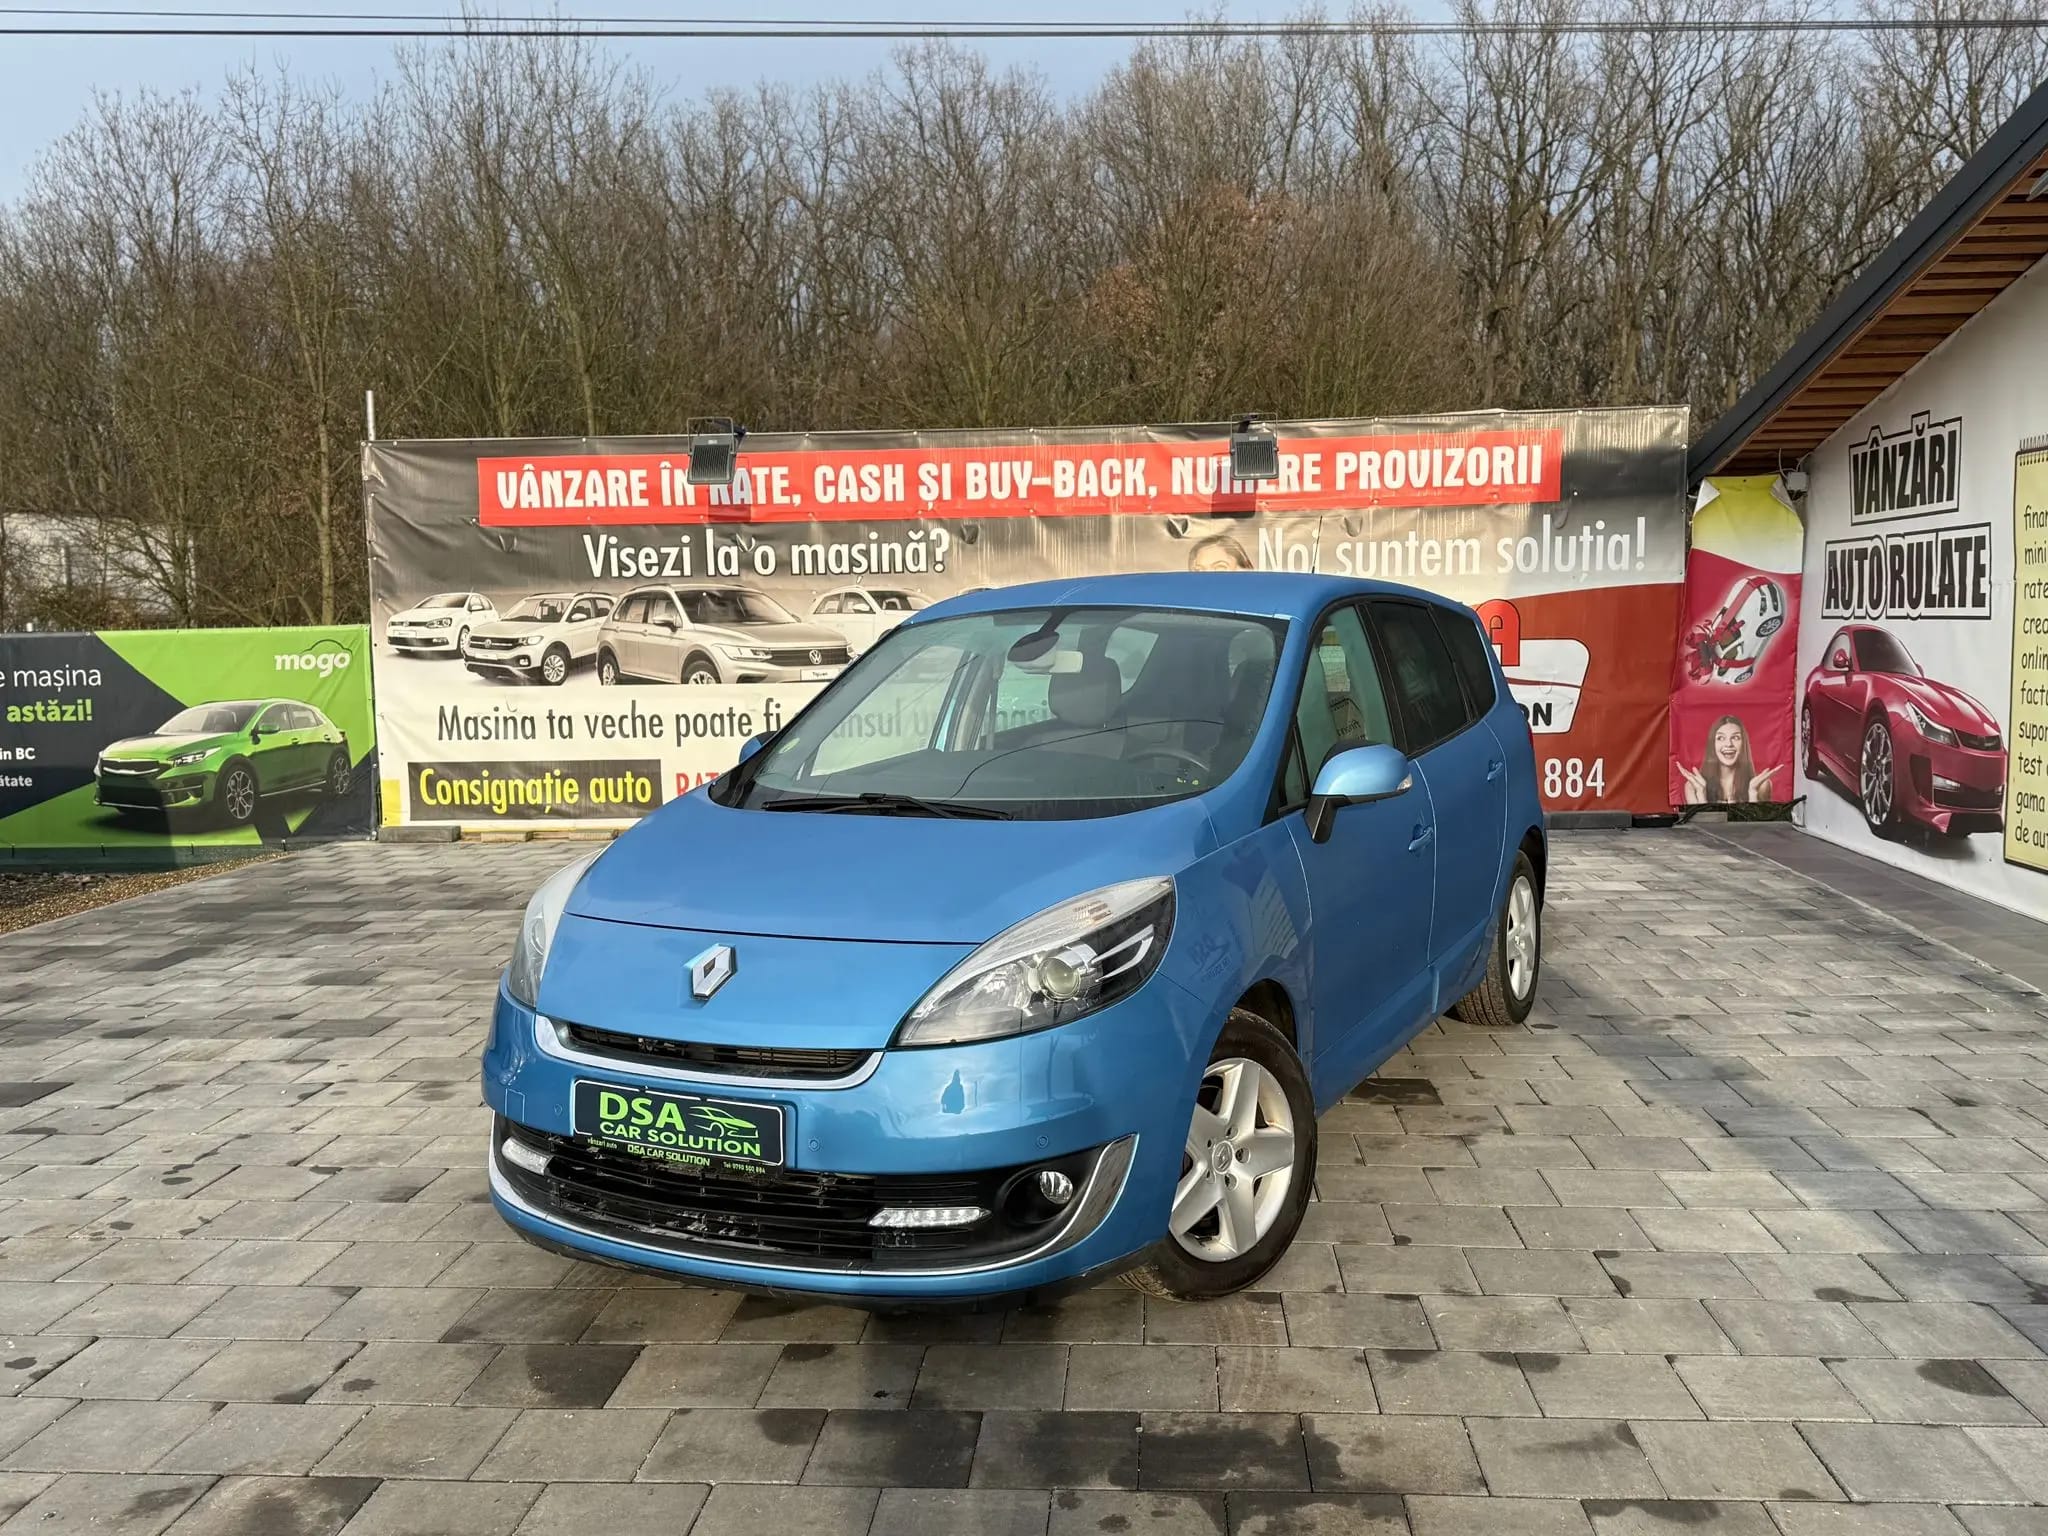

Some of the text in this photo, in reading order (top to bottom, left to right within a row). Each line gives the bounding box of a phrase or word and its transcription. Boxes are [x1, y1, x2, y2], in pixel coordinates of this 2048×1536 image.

[497, 464, 649, 508] VÂNZARE
[660, 461, 697, 506] ÎN
[814, 463, 905, 503] CASH
[965, 457, 1158, 499] BUY-BACK,
[1335, 444, 1543, 490] PROVIZORII
[1852, 423, 1957, 516] VÂNZĂRI
[582, 534, 692, 578] Visezi
[705, 528, 740, 577] la
[753, 543, 777, 576] o
[1258, 514, 1646, 582] Noi suntem soluția!
[1825, 535, 1986, 610] AUTO RULATE
[2024, 578, 2048, 600] rate
[13, 664, 102, 692] mașina
[274, 651, 351, 678] mogo
[6, 698, 93, 722] astăzi!
[546, 709, 574, 739] ta
[584, 699, 664, 740] veche
[675, 706, 753, 748] poate
[763, 697, 783, 732] fi
[15, 747, 36, 761] BC
[2018, 751, 2043, 777] test
[419, 767, 652, 814] Consignație auto
[1543, 757, 1605, 798] 884
[2016, 791, 2046, 814] gama
[2015, 818, 2030, 844] de
[600, 1091, 686, 1132] DSA
[600, 1121, 761, 1157] CAR SOLUTION
[627, 1144, 711, 1167] DSA CAR SOLUTION
